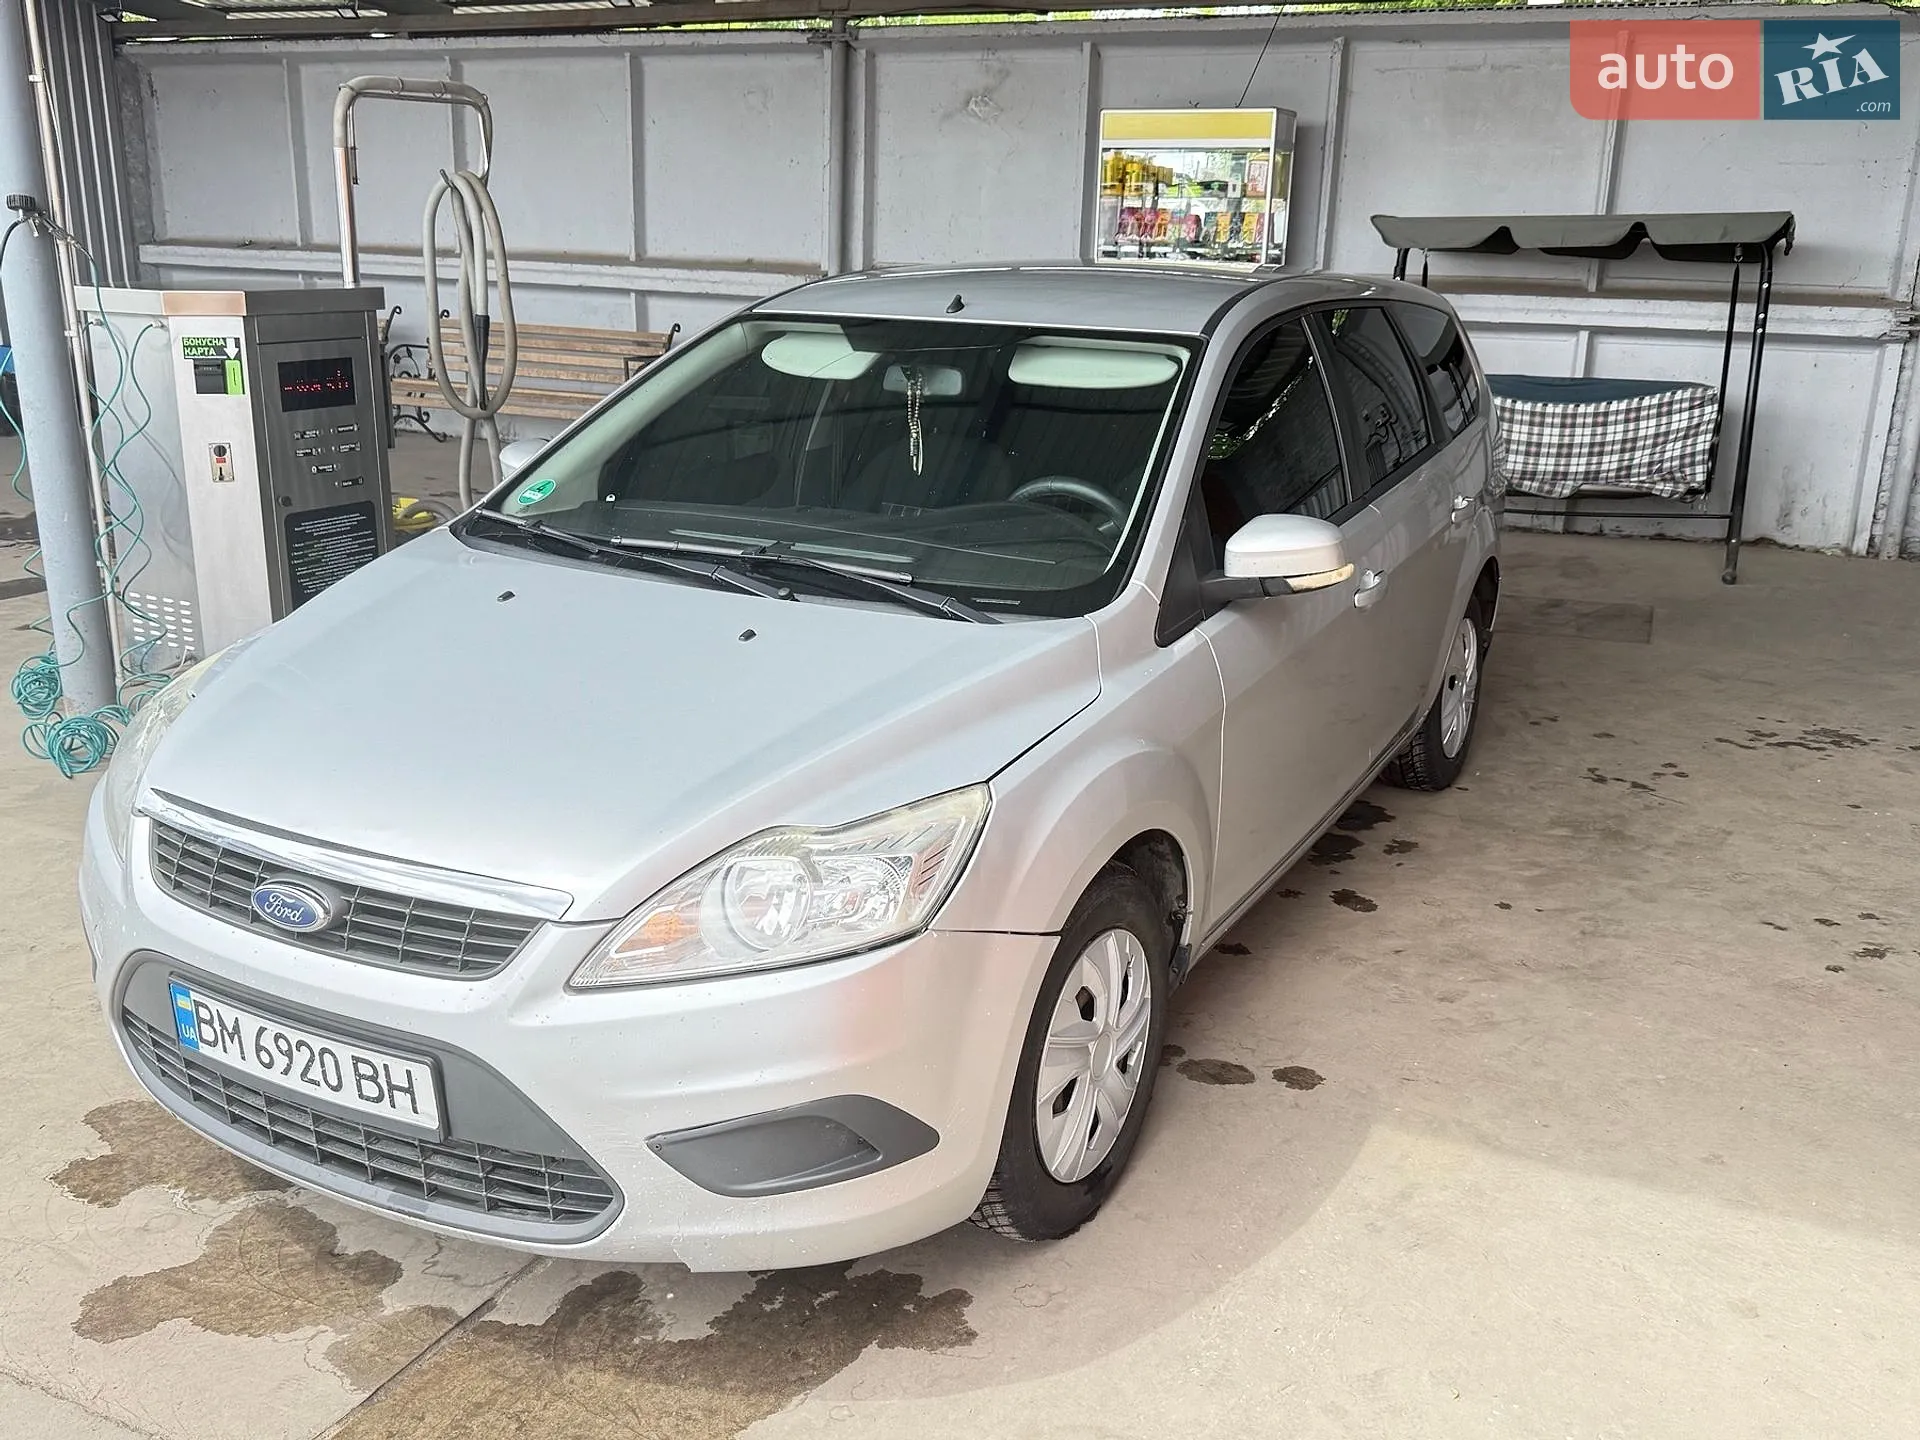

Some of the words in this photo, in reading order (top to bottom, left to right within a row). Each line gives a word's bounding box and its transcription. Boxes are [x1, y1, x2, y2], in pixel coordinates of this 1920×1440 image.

[183, 338, 226, 346] БОНУСНА
[184, 347, 217, 356] КАРТА
[264, 893, 305, 922] Ford
[181, 1024, 198, 1042] UA
[193, 999, 247, 1062] BM
[254, 1026, 344, 1093] 6920
[351, 1055, 419, 1115] BH
